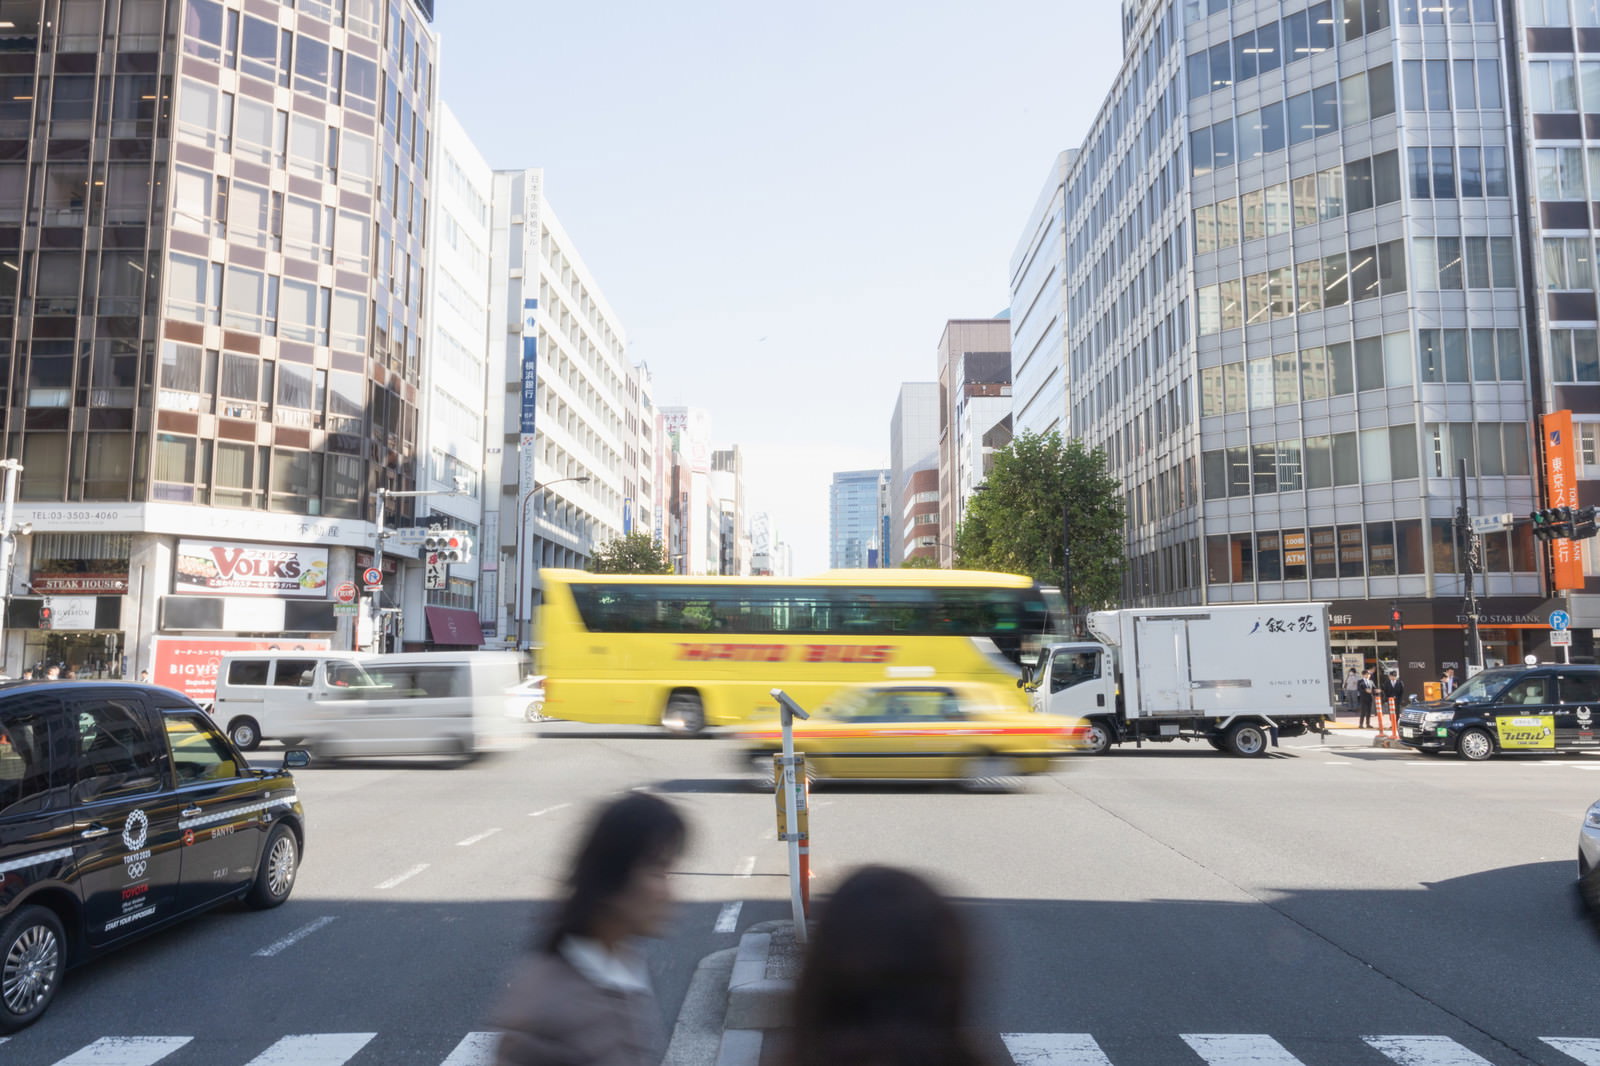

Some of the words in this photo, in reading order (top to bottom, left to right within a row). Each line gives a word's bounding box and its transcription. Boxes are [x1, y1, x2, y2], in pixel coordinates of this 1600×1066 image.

[525, 361, 535, 398] 横浜銀行
[32, 511, 119, 520] TEL:03-3503-4060
[1552, 457, 1568, 562] 東京ス銀行
[209, 546, 300, 579] VOLKS
[1286, 555, 1304, 563] ATM
[47, 580, 79, 589] STEAK
[82, 580, 119, 590] HOUS
[1265, 614, 1317, 633] 叙々苑
[1490, 615, 1513, 623] STAR
[1515, 615, 1540, 623] BANK
[211, 825, 234, 840] SANYO
[123, 853, 139, 864] TOKYO
[140, 849, 152, 860] 2020
[213, 867, 229, 880] TAXI
[121, 884, 149, 900] TOYOTA
